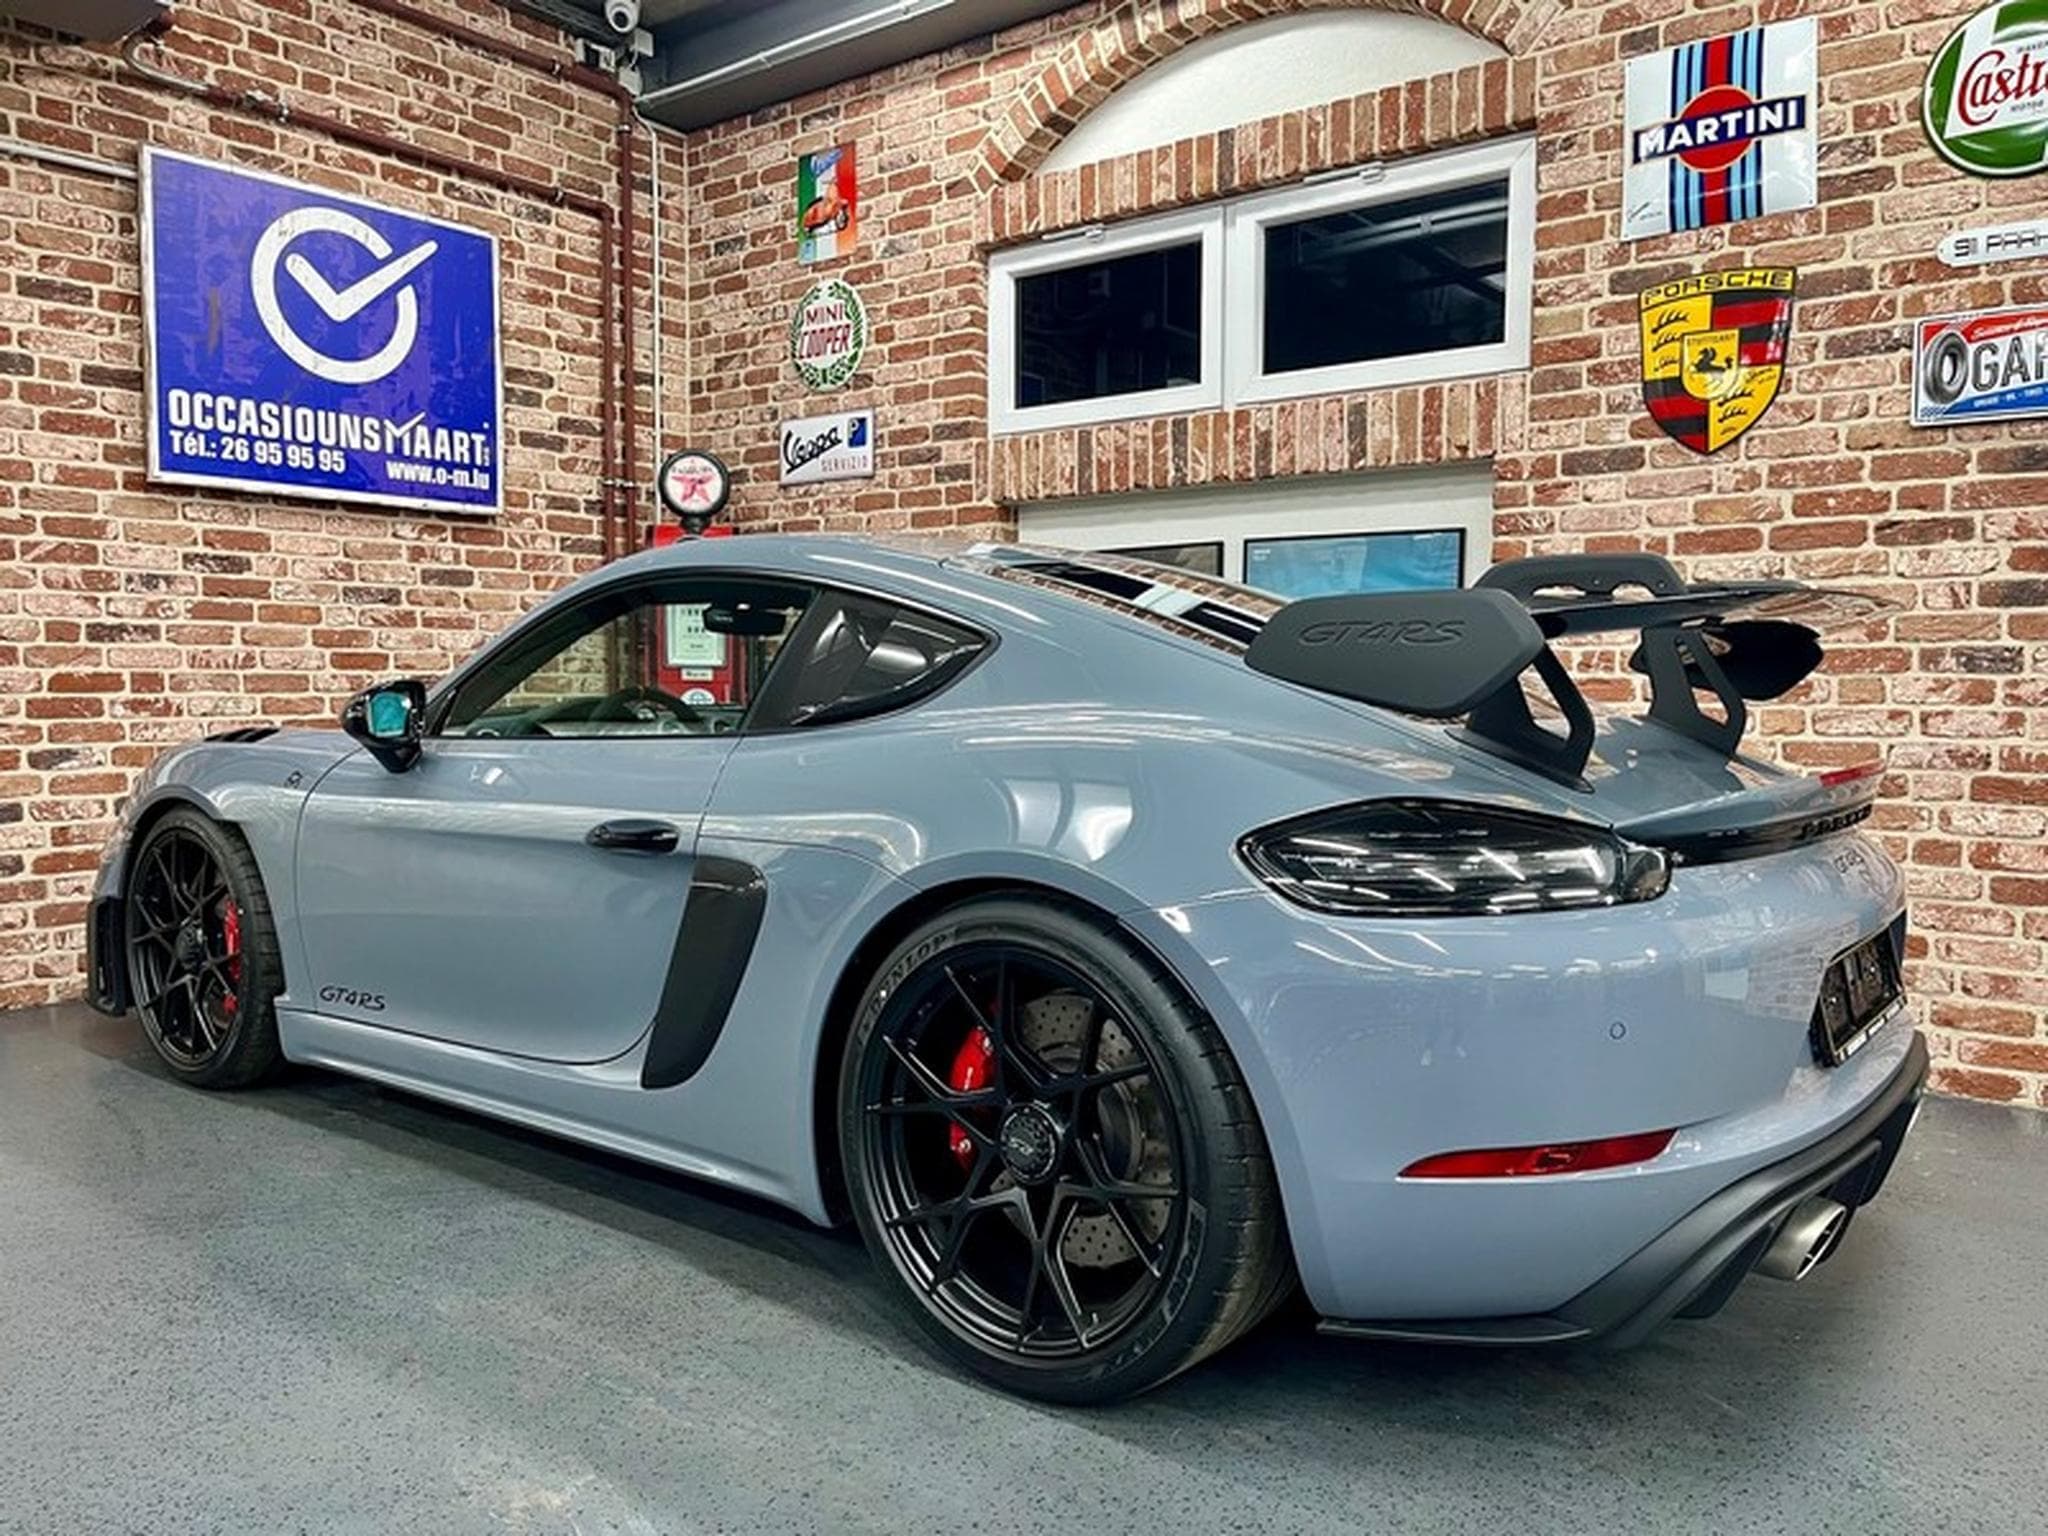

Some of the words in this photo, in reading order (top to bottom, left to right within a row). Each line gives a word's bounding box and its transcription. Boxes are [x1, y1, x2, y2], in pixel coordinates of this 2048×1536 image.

[1958, 50, 2048, 126] Castr
[1639, 100, 1797, 157] MARTINI
[1645, 271, 1790, 305] PORSCHE
[806, 303, 843, 325] MINI
[799, 323, 851, 359] COOPER
[170, 429, 217, 459] Tél.:
[220, 437, 250, 462] 26
[254, 440, 283, 466] 95
[287, 444, 316, 470] 95
[319, 448, 347, 473] 95
[783, 429, 843, 475] Vespa
[385, 460, 490, 490] www.o-m.lu
